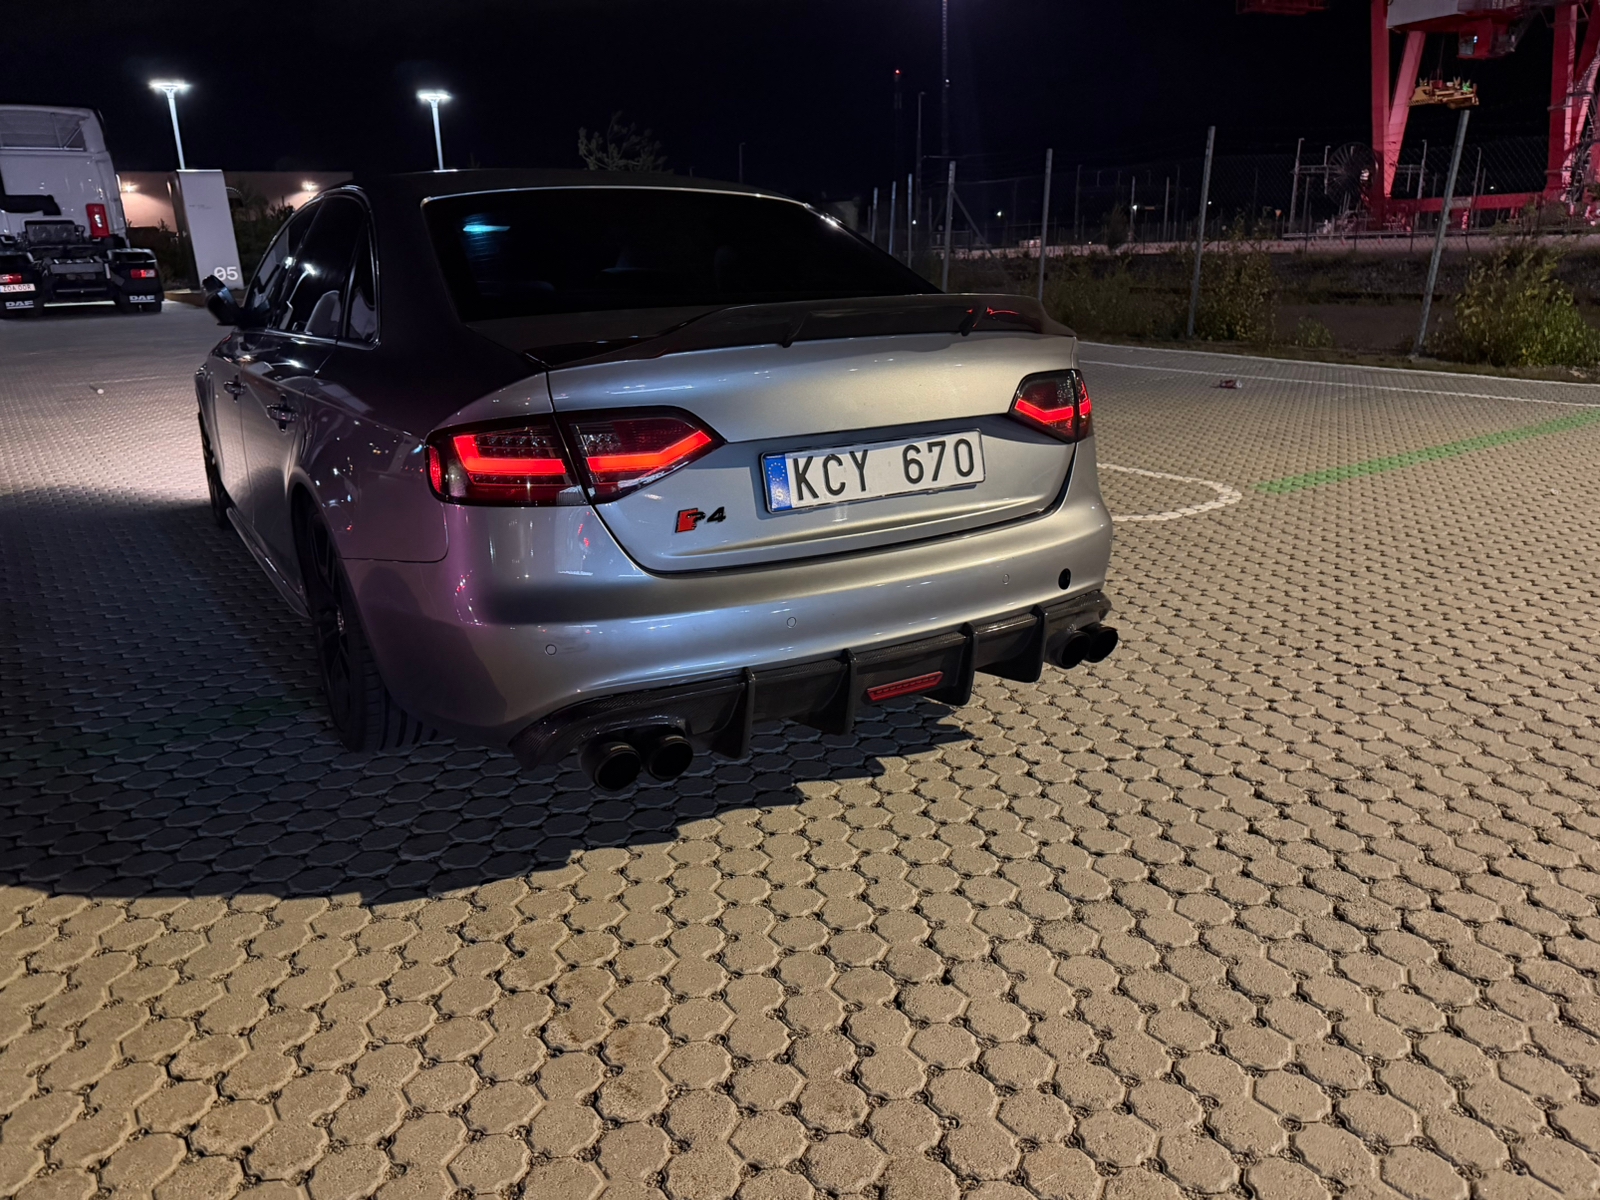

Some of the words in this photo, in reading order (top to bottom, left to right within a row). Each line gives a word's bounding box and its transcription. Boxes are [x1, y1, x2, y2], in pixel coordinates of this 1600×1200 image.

[793, 449, 869, 501] KCY
[902, 438, 975, 485] 670
[775, 488, 784, 500] S
